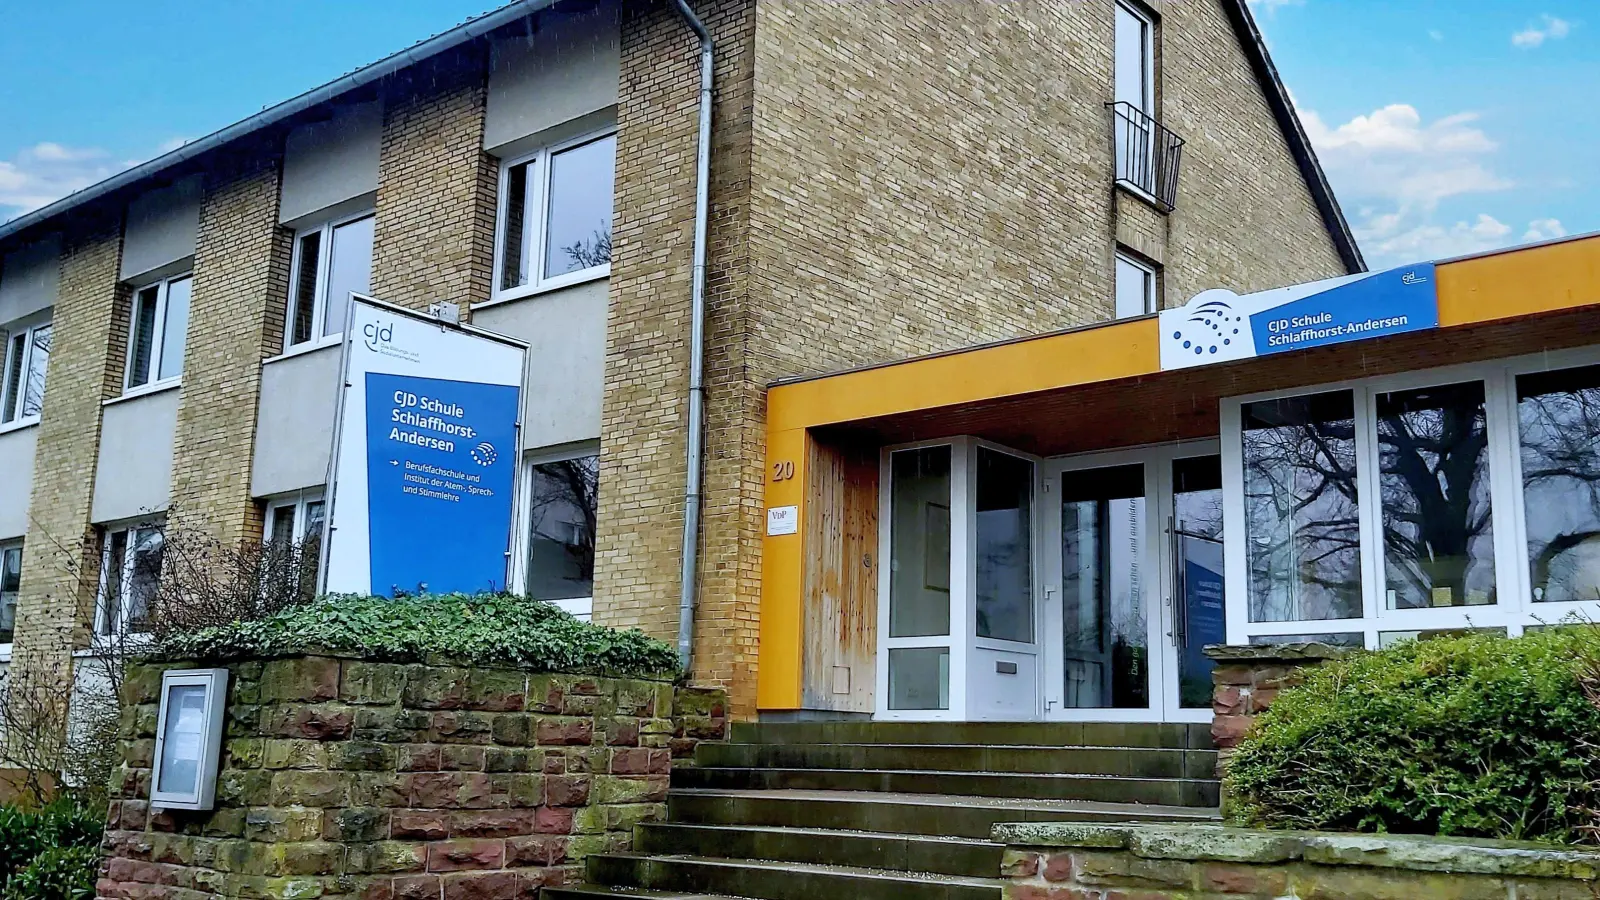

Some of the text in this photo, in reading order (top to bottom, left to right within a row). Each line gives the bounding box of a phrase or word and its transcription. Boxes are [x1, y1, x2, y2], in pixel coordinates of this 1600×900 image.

[1402, 271, 1415, 282] cjd
[363, 320, 394, 345] cjd
[1268, 312, 1332, 333] CJD Schule
[1268, 315, 1408, 346] Schlaffhorst-Andersen
[393, 391, 464, 418] CJD Schule
[391, 409, 477, 438] Schlaffhorst-
[389, 428, 454, 452] Andersen
[405, 461, 481, 482] Berufsfachschule und
[773, 461, 794, 482] 20
[403, 486, 460, 502] und Stimmlehre
[404, 473, 430, 485] Institut
[431, 478, 443, 487] der
[468, 485, 494, 496] Sprech-
[1128, 499, 1137, 536] ausbilden
